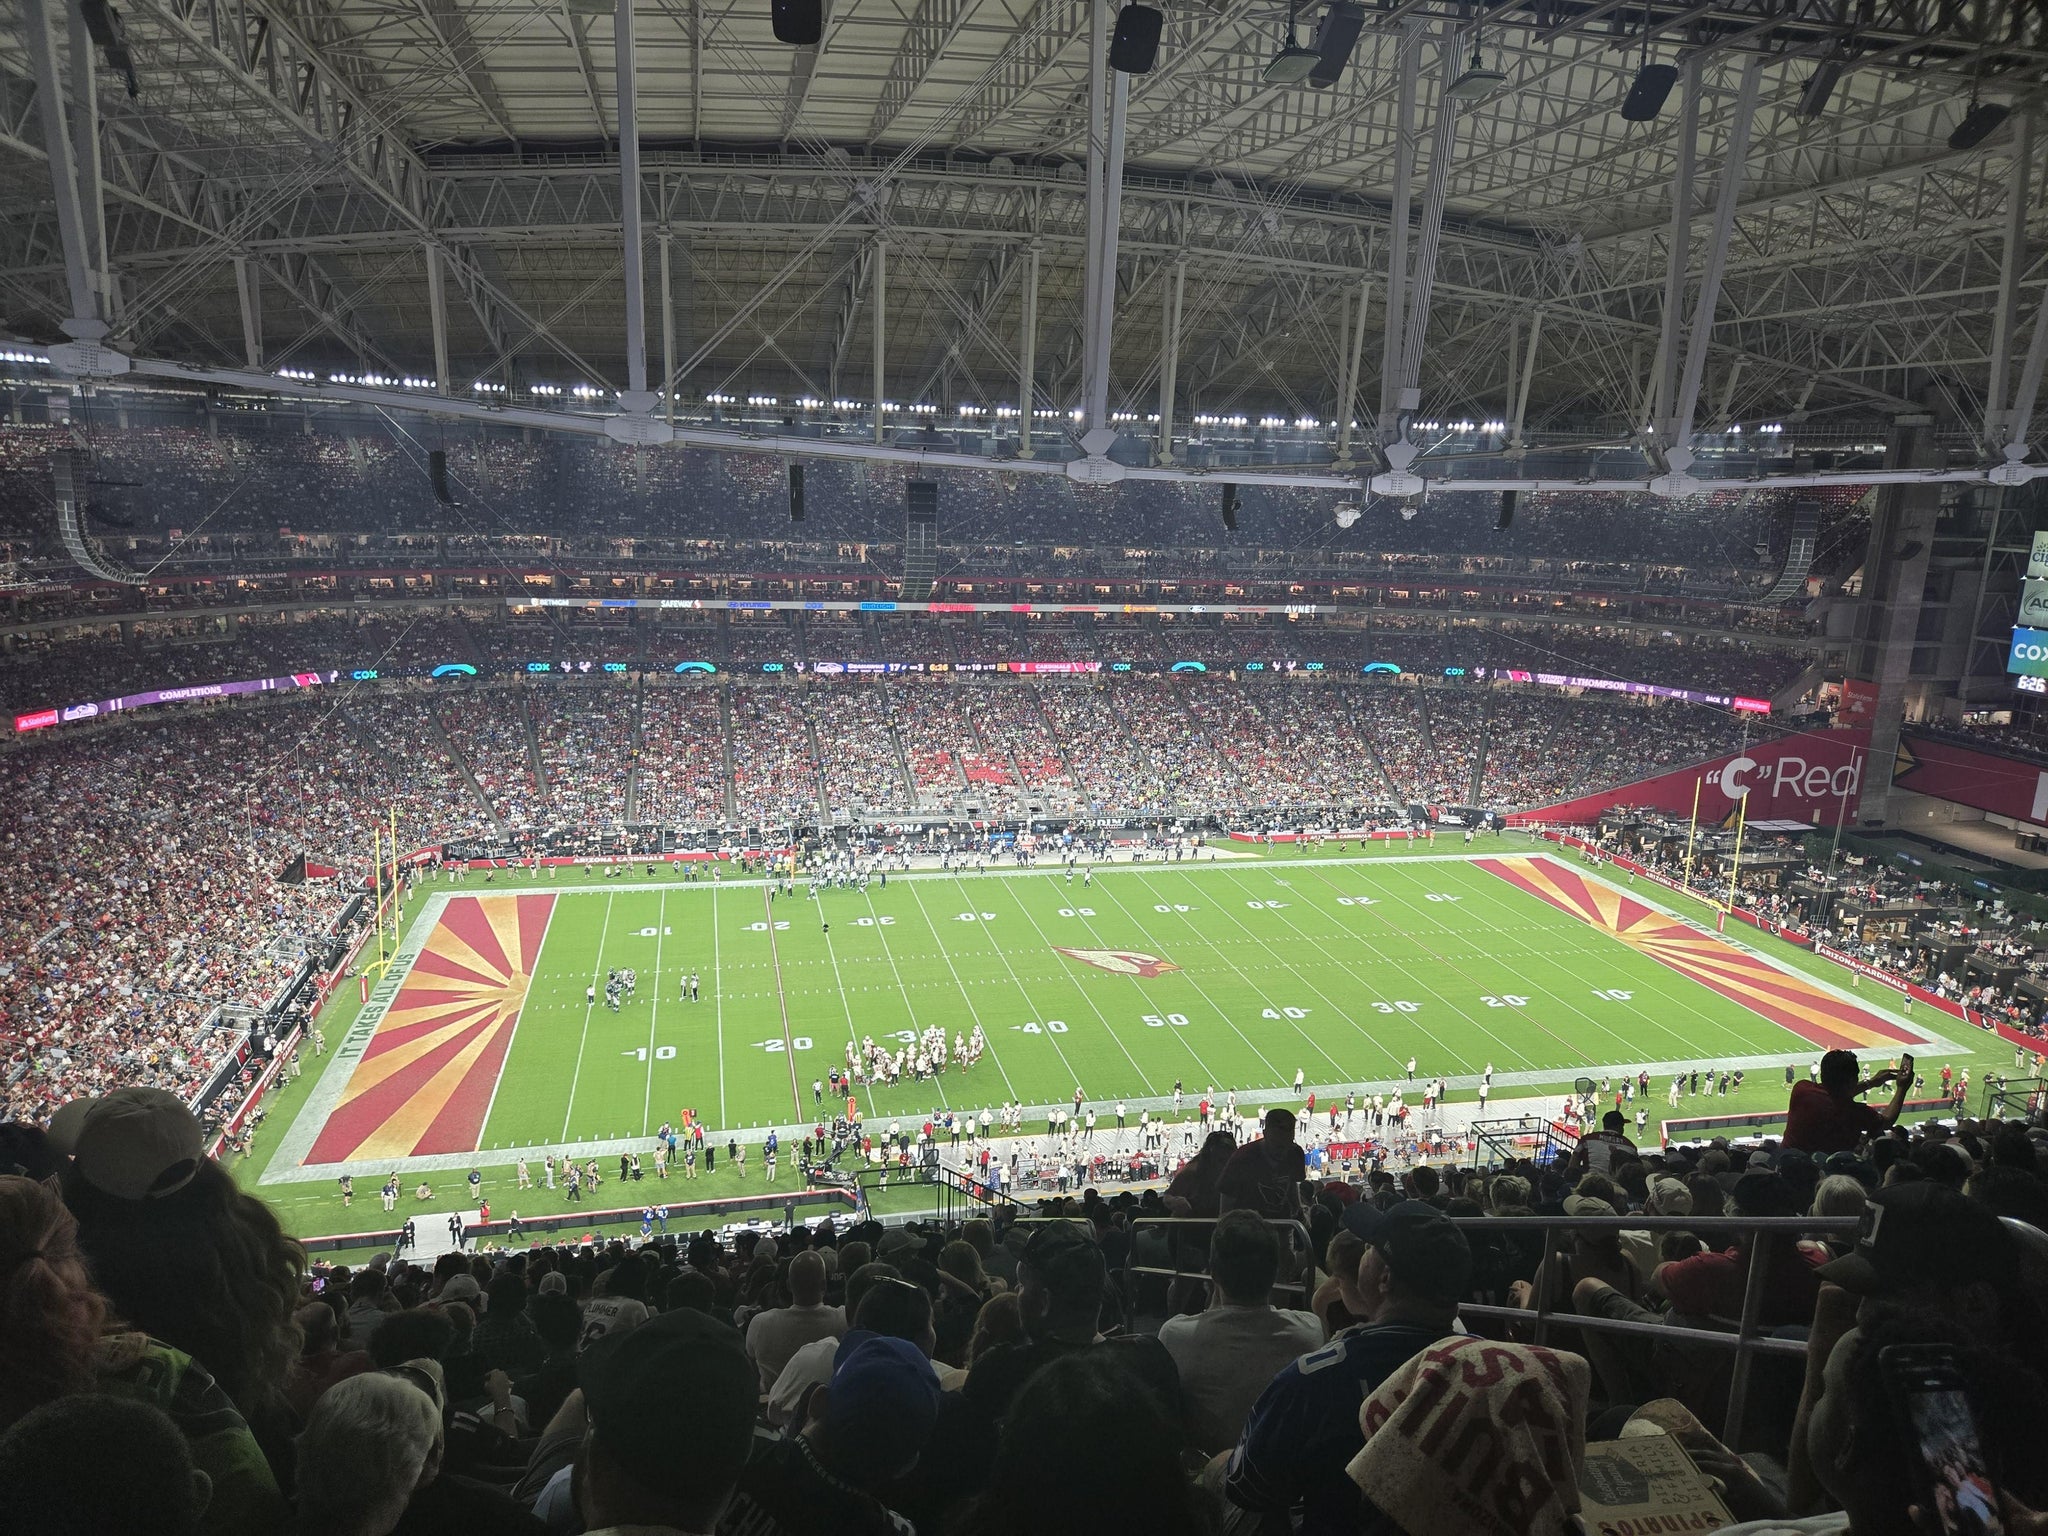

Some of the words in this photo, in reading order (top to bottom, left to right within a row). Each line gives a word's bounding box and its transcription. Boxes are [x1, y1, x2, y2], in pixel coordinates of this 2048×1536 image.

[25, 586, 44, 594] OLLIE
[45, 584, 72, 592] MATSON
[660, 600, 693, 608] SAFEWAY
[1284, 604, 1317, 614] AVNET
[1723, 603, 1740, 611] JIMMY
[1743, 605, 1781, 613] CONZELMAN
[528, 662, 550, 672] COX
[604, 662, 627, 672] COX
[763, 662, 784, 672] COX
[889, 663, 901, 672] 17
[1113, 662, 1131, 671] COX
[1246, 662, 1264, 670] COX
[1306, 662, 1324, 670] COX
[1445, 667, 1465, 676] COX
[353, 670, 378, 680] COX
[159, 685, 222, 700] COMPLETIONS
[1772, 755, 1863, 798] Red
[573, 856, 613, 864] ARIZONA
[1645, 871, 1672, 888] ARIZONA
[391, 953, 416, 966] US
[384, 967, 407, 981] OF
[1820, 945, 1856, 968] ARIZONA
[1860, 964, 1908, 992] CARDINALS
[371, 983, 399, 1003] ALL
[1591, 989, 1632, 1001] 10
[1371, 1000, 1418, 1013] 30
[1479, 994, 1528, 1008] 20
[1261, 1006, 1306, 1020] 40
[346, 1006, 386, 1044] TAKES
[1141, 1013, 1190, 1027] 50
[1022, 1020, 1069, 1034] 40
[764, 1036, 813, 1053] 20
[337, 1047, 362, 1059] IT
[636, 1045, 677, 1061] 10
[1642, 1444, 1678, 1489] FAMILY
[1655, 1442, 1704, 1502] KITCHEN
